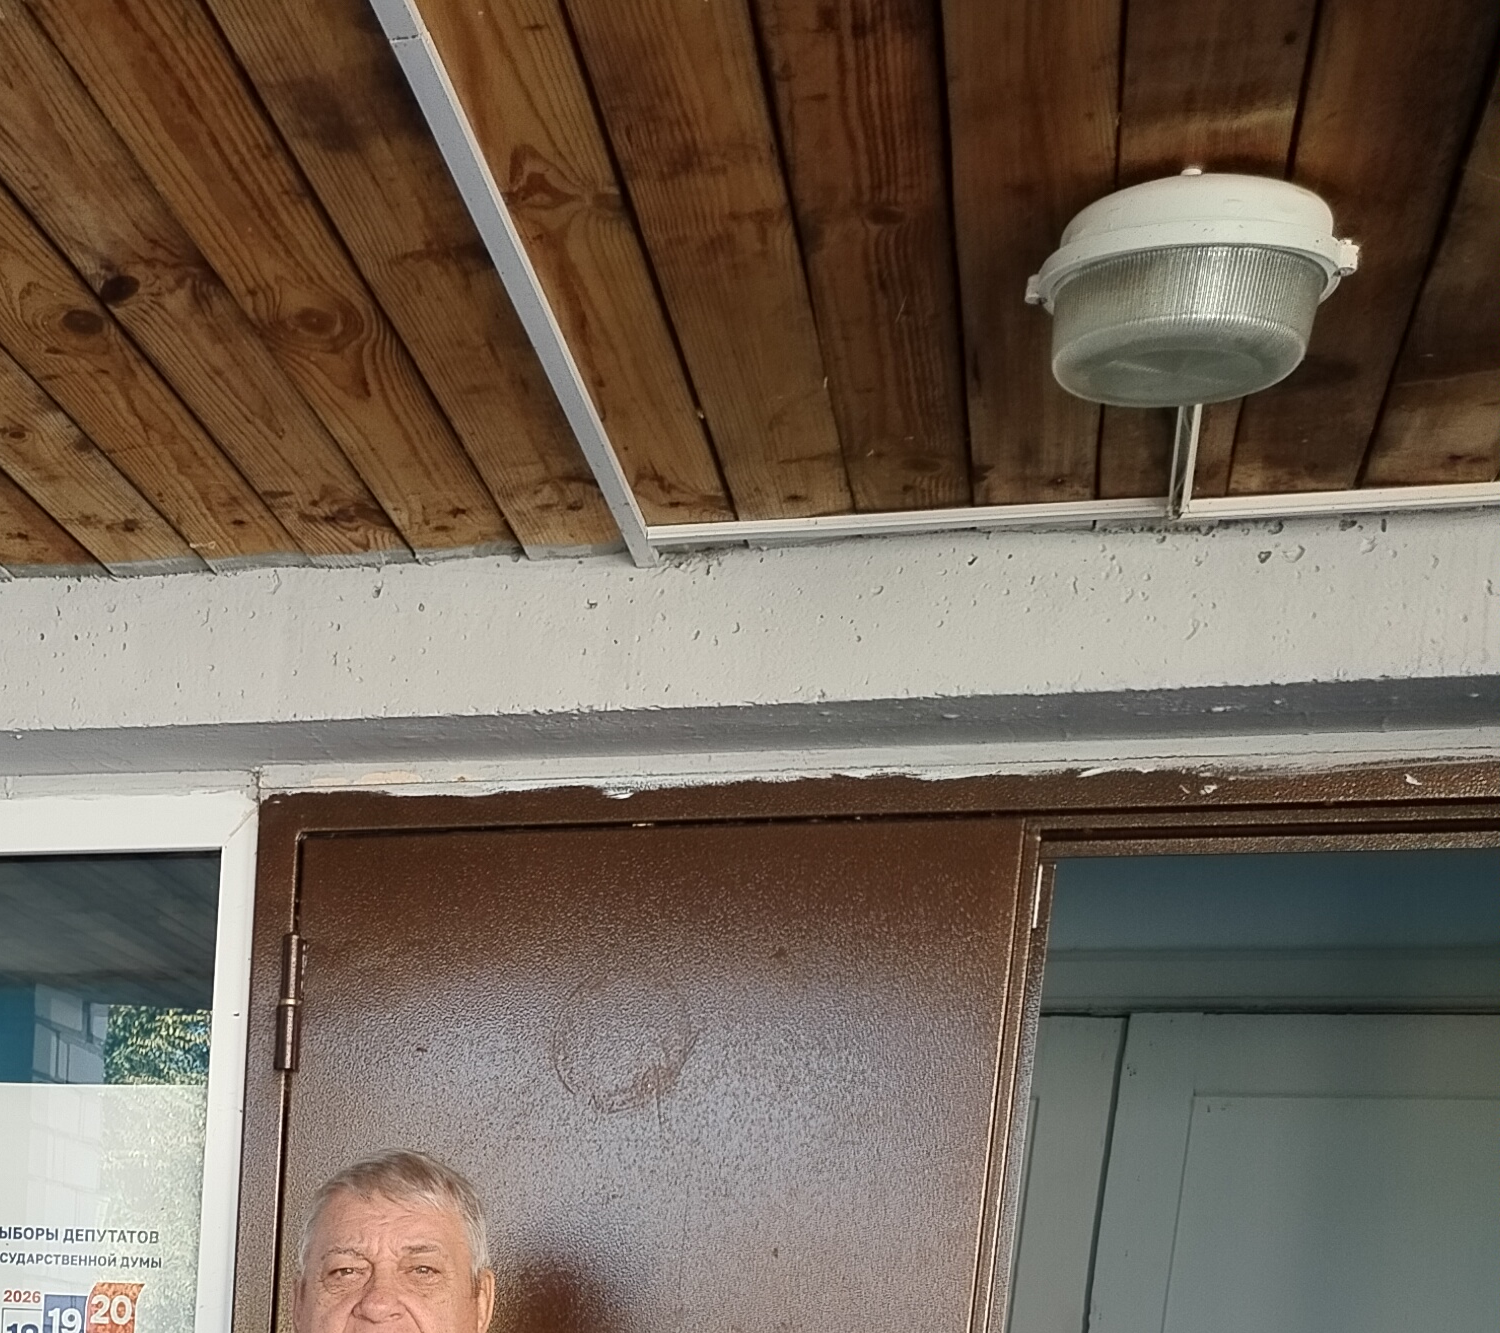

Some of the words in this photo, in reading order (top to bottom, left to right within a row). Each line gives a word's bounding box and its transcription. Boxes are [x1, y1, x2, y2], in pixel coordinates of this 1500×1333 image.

[63, 1228, 160, 1244] ДЕПУТАТОВ
[120, 1256, 162, 1268] ДУМЫ
[3, 1290, 41, 1303] 2026
[90, 1295, 132, 1325] 20
